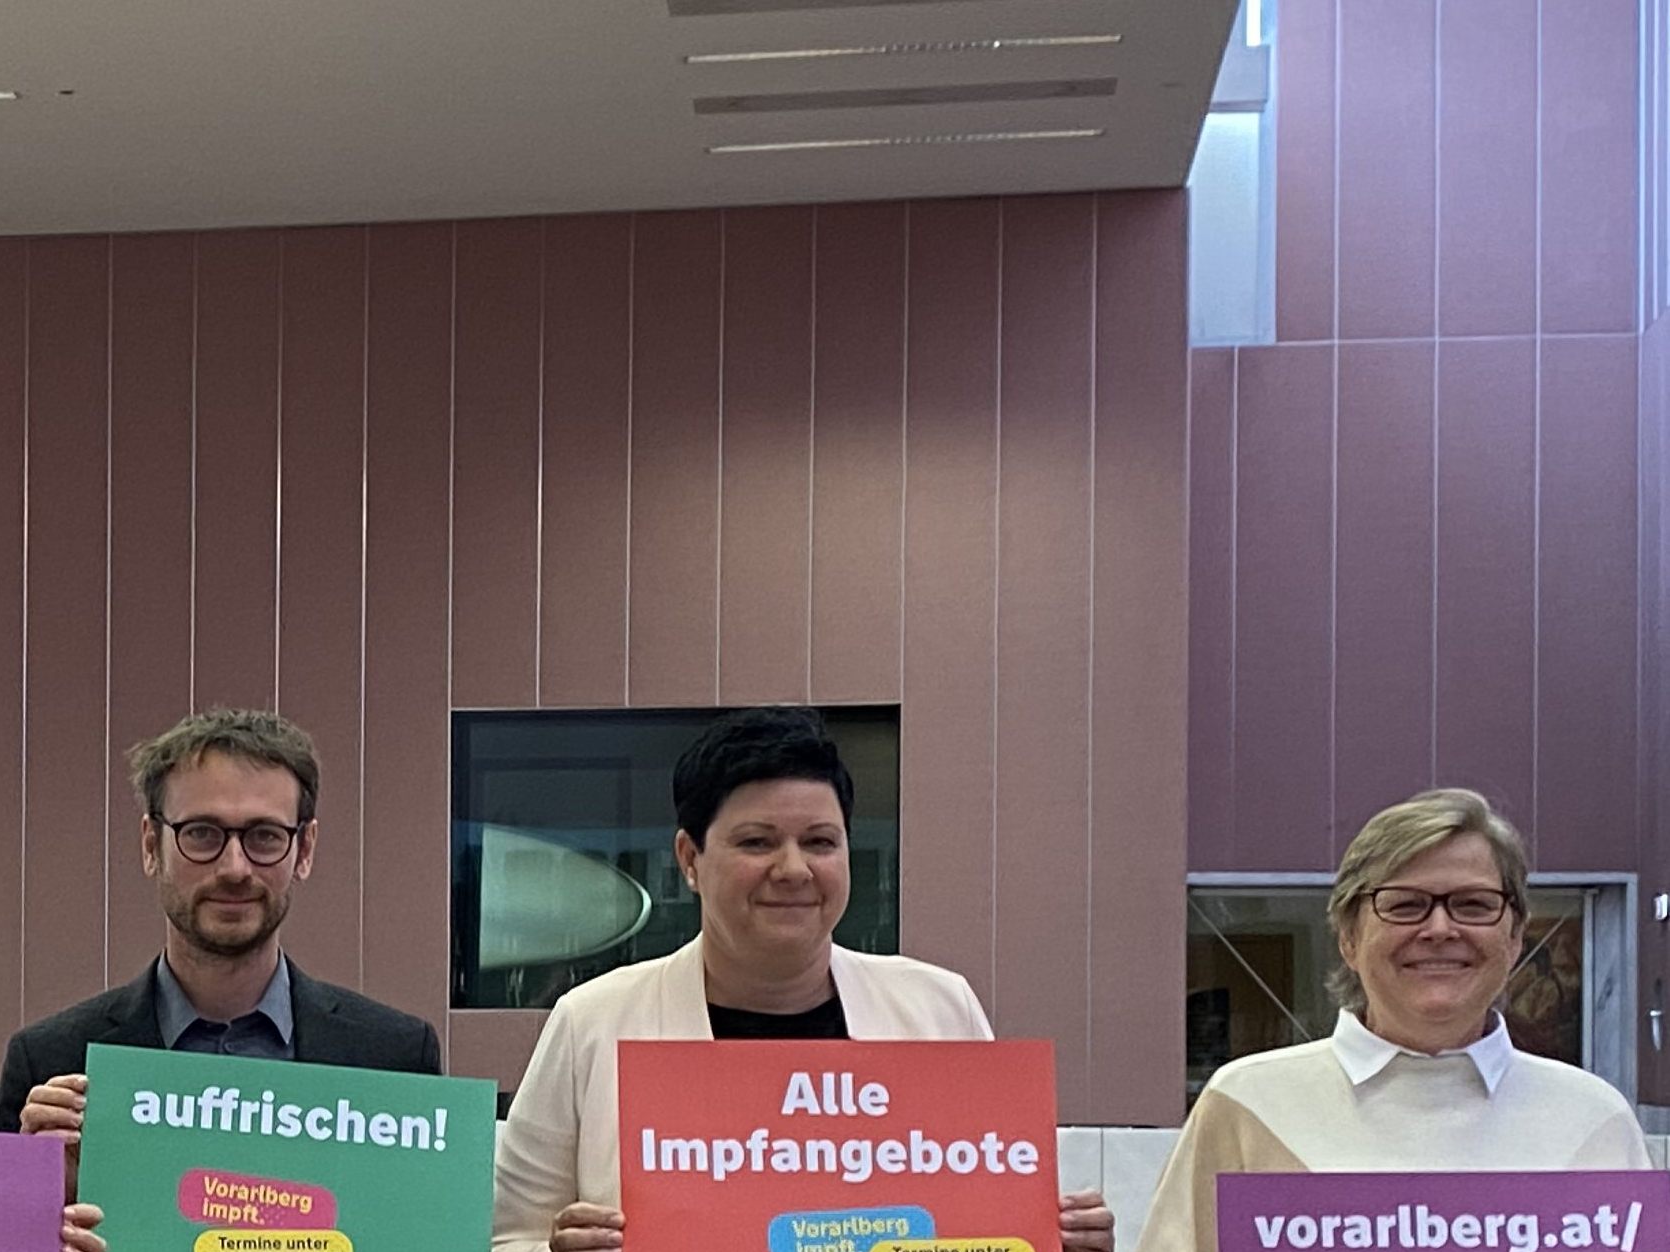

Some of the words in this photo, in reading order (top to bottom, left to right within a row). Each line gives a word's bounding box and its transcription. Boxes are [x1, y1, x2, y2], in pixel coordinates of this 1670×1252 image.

[781, 1071, 890, 1117] Alle
[132, 1086, 448, 1152] auffrischen!
[641, 1128, 1040, 1183] Impfangebote
[202, 1175, 314, 1213] Vorarlberg
[202, 1199, 266, 1226] impft.
[218, 1236, 282, 1250] Termine
[286, 1237, 330, 1250] unter
[791, 1216, 910, 1239] Vorarlberg
